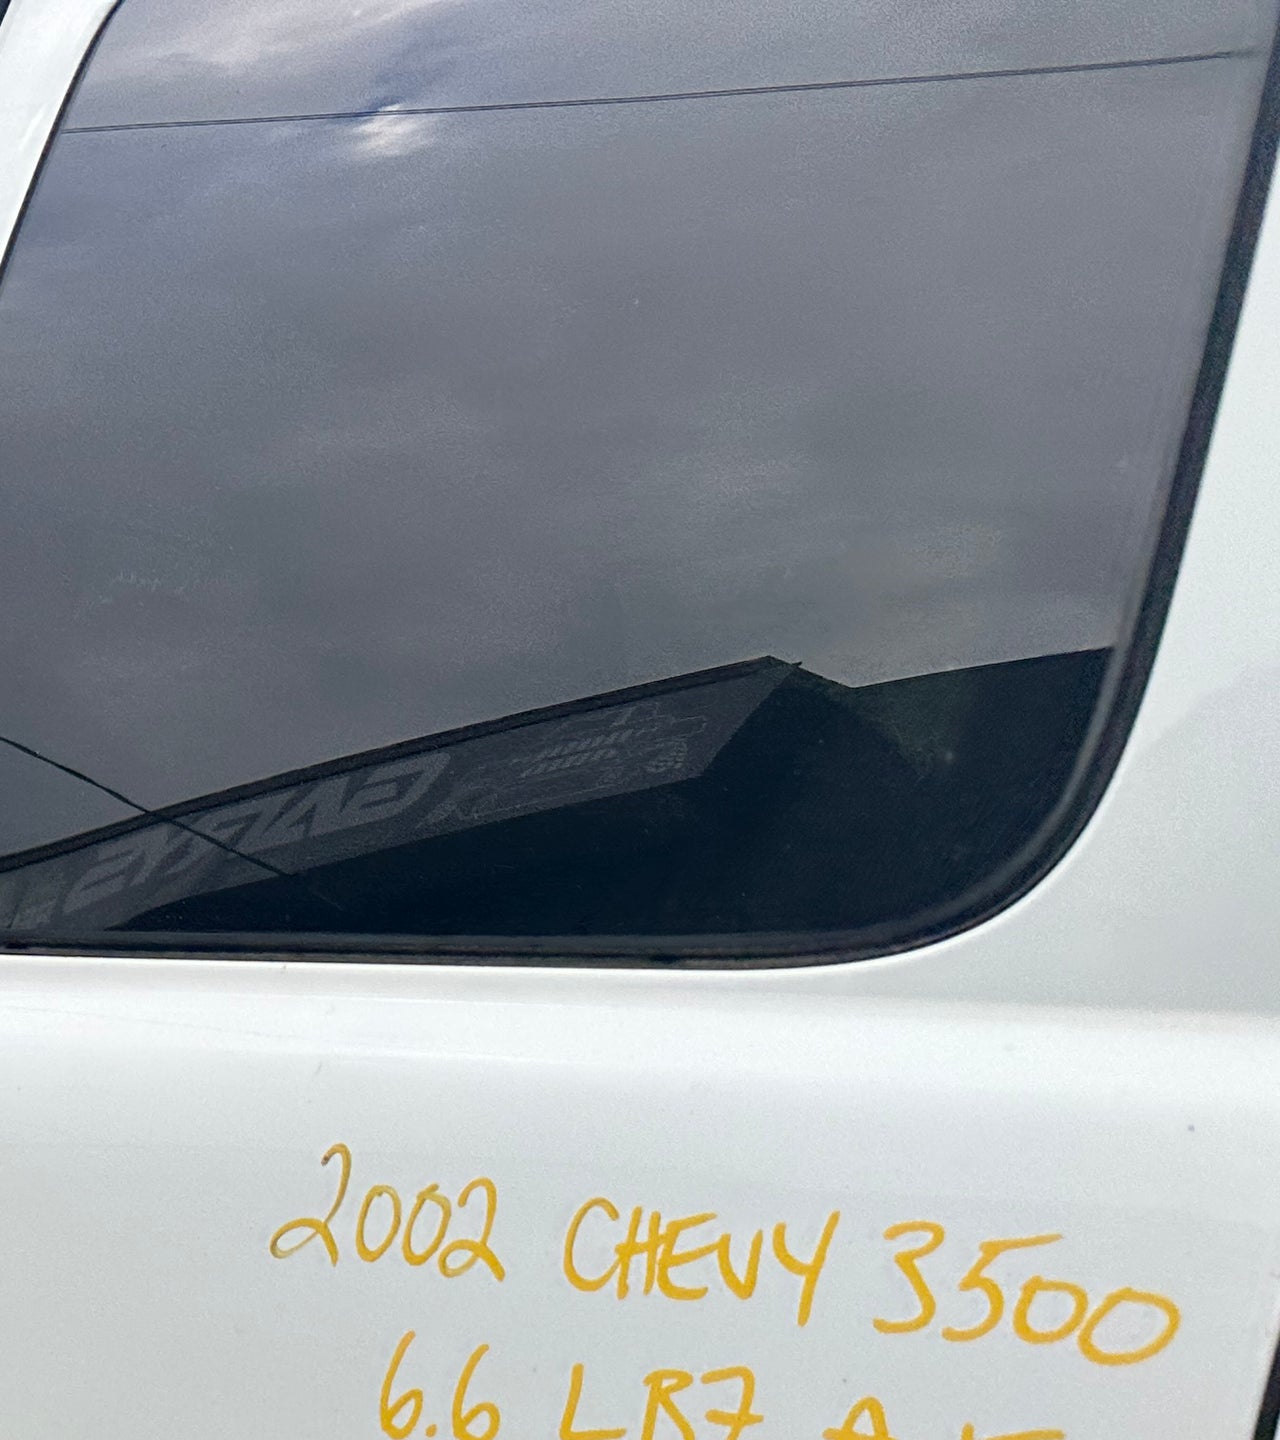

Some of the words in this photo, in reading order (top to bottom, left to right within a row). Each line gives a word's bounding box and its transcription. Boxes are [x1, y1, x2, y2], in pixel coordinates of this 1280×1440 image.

[269, 1143, 506, 1282] 2002
[563, 1197, 841, 1327] CHEVY
[873, 1220, 1182, 1366] 3500
